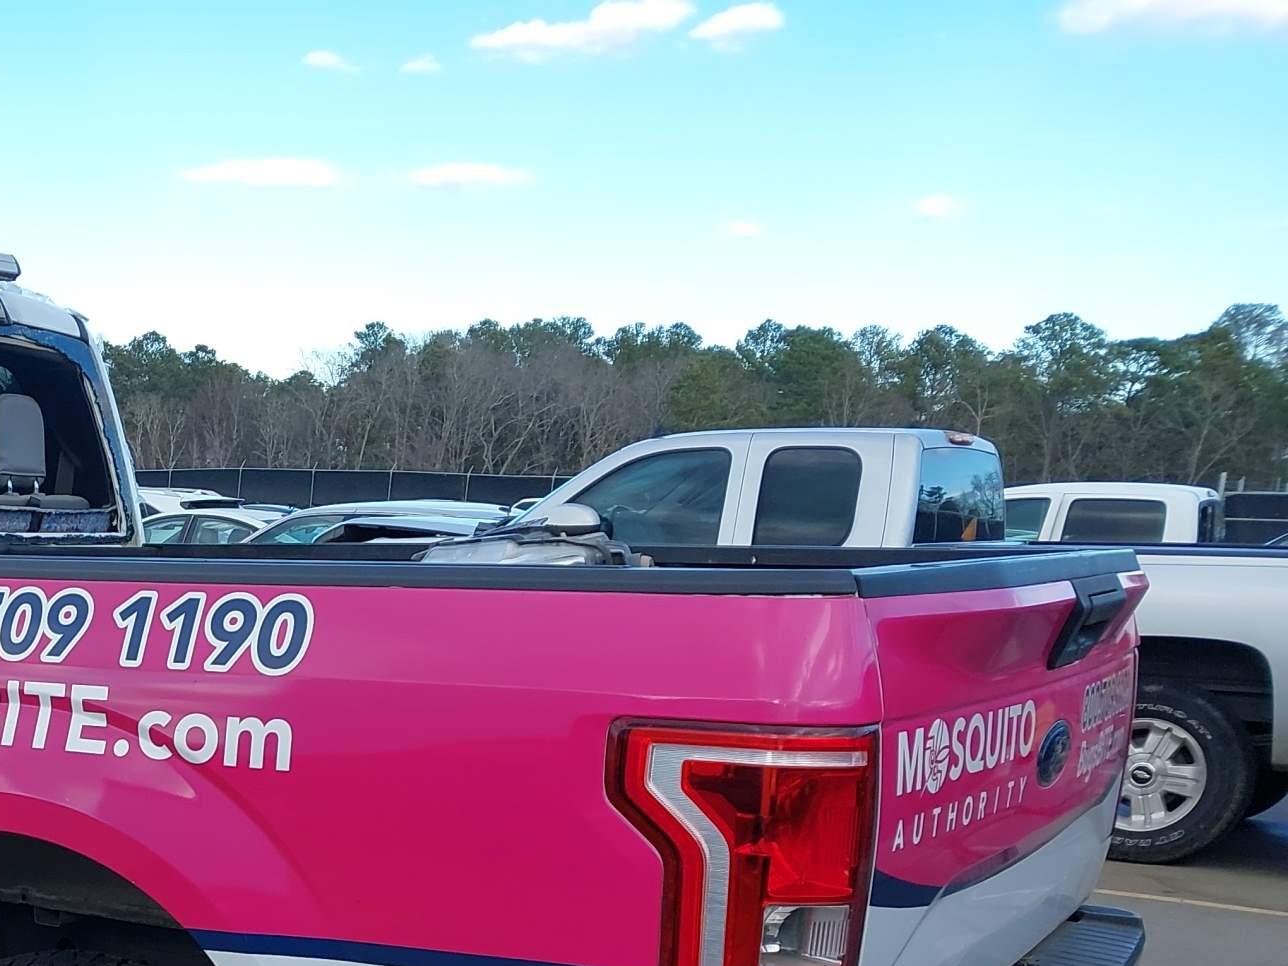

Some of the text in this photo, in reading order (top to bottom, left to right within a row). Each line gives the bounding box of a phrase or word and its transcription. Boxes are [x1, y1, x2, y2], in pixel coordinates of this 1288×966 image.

[113, 590, 314, 677] 1190
[896, 699, 1037, 797] MOSQUITO
[892, 776, 1029, 852] AUTHORITY
